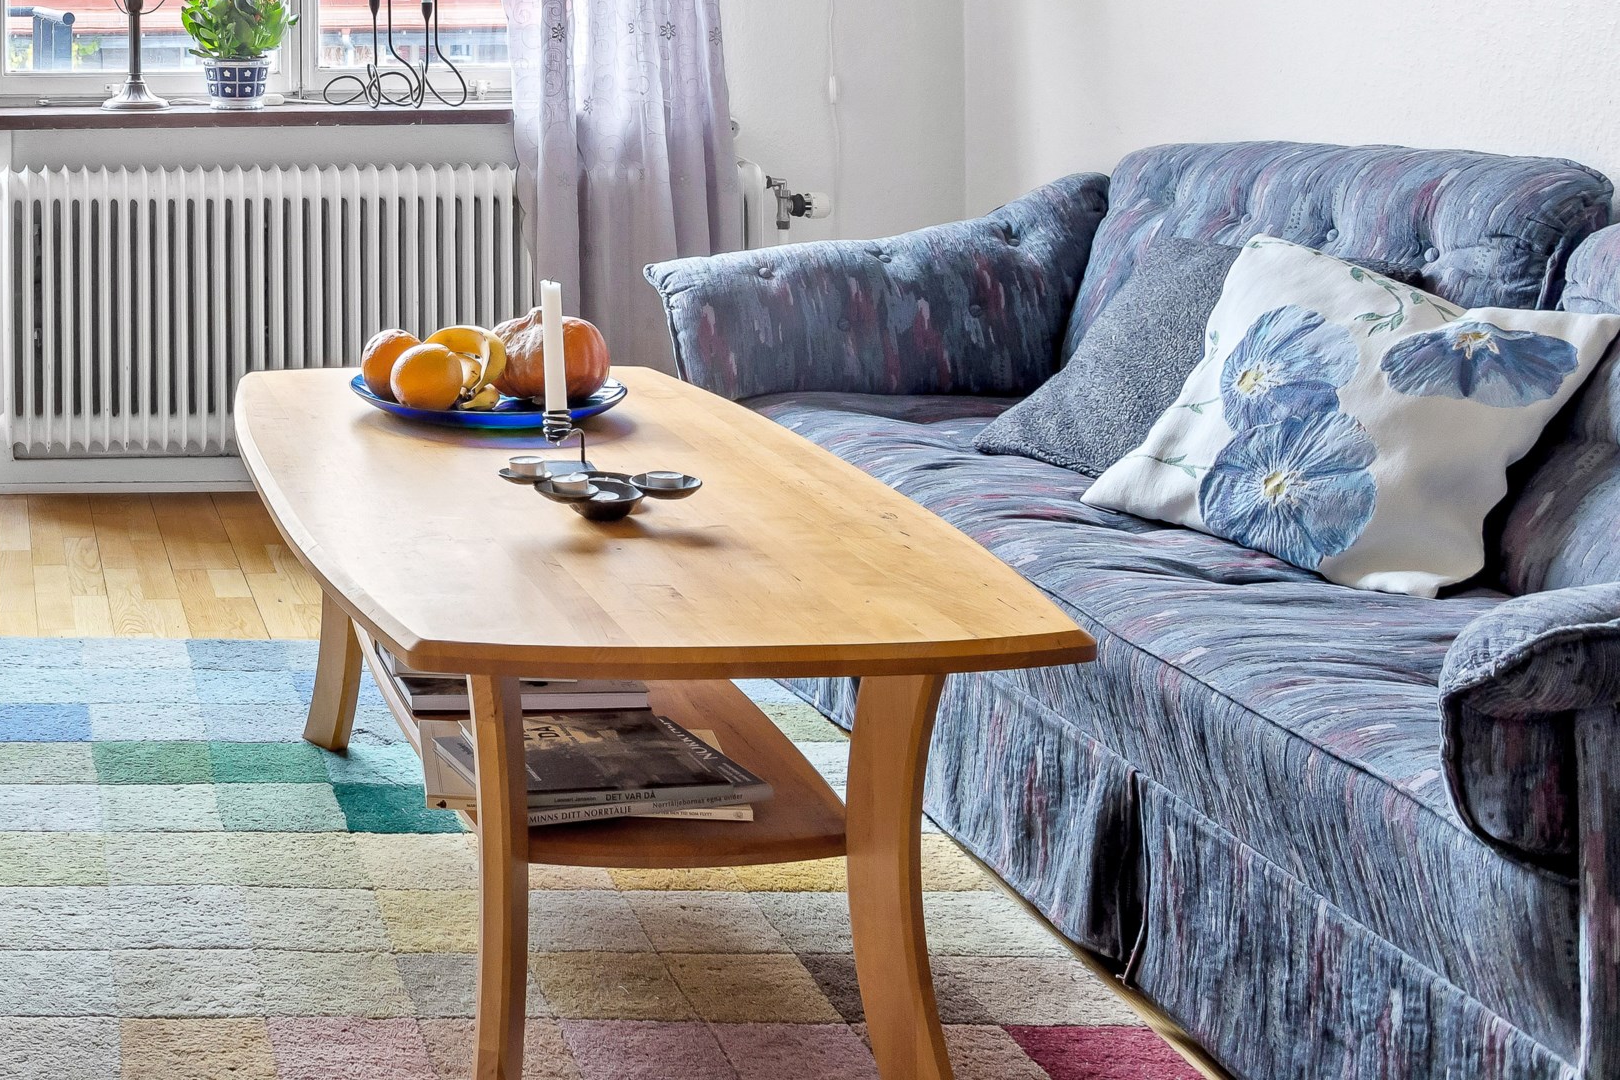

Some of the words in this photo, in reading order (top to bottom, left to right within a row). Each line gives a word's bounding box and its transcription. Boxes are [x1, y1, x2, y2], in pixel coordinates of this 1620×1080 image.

[605, 793, 622, 802] DET
[624, 792, 642, 801] VAR
[643, 789, 656, 800] DÅ
[528, 814, 559, 824] MINNS
[561, 811, 581, 820] DITT
[583, 805, 632, 818] NORRTÄLJE
[652, 798, 705, 809] Norrtäljebornas
